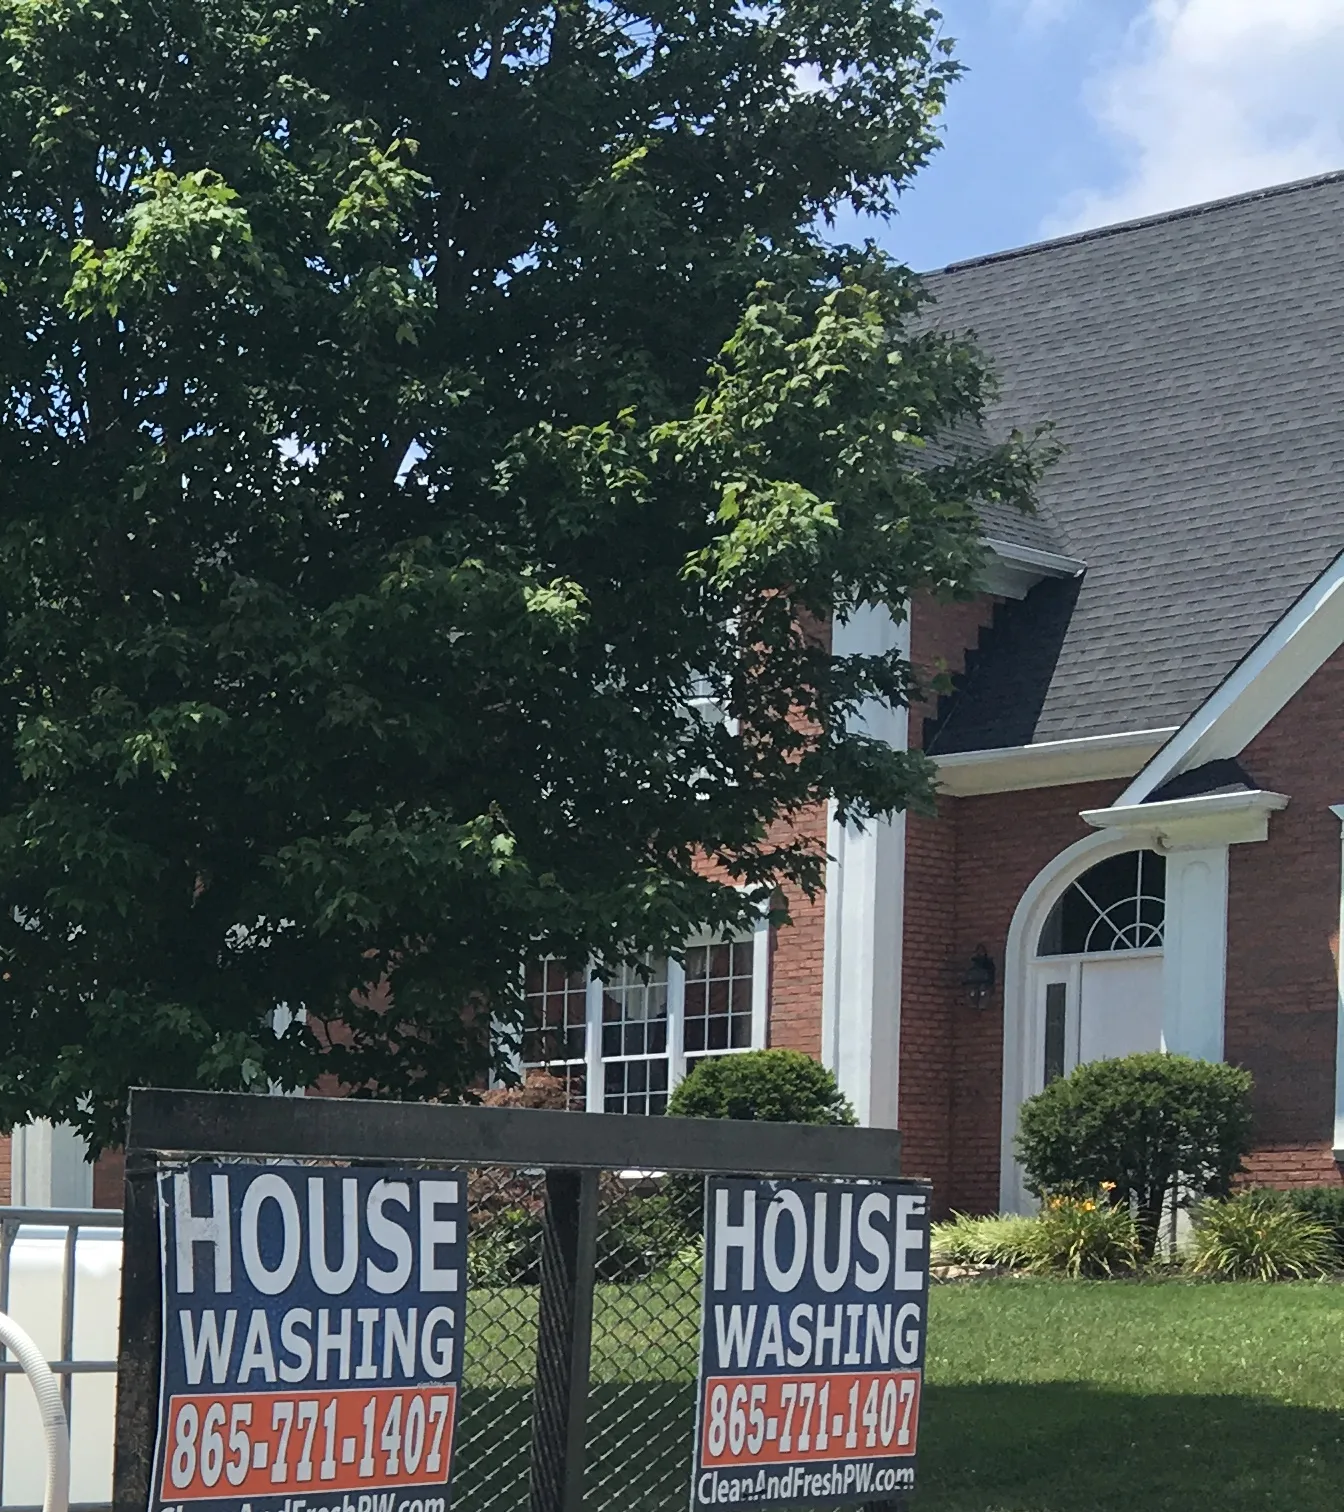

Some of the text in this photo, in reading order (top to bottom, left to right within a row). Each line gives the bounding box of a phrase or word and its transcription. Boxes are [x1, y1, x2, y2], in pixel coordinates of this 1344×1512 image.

[174, 1173, 459, 1295] HOUSE
[713, 1188, 927, 1293] HOUSE
[179, 1306, 455, 1384] WASHING
[714, 1302, 921, 1368] WASHING
[171, 1395, 450, 1489] 865-771-1407
[708, 1379, 916, 1457] 865-771-1407
[698, 1463, 914, 1505] CleanAndFreshPW.com
